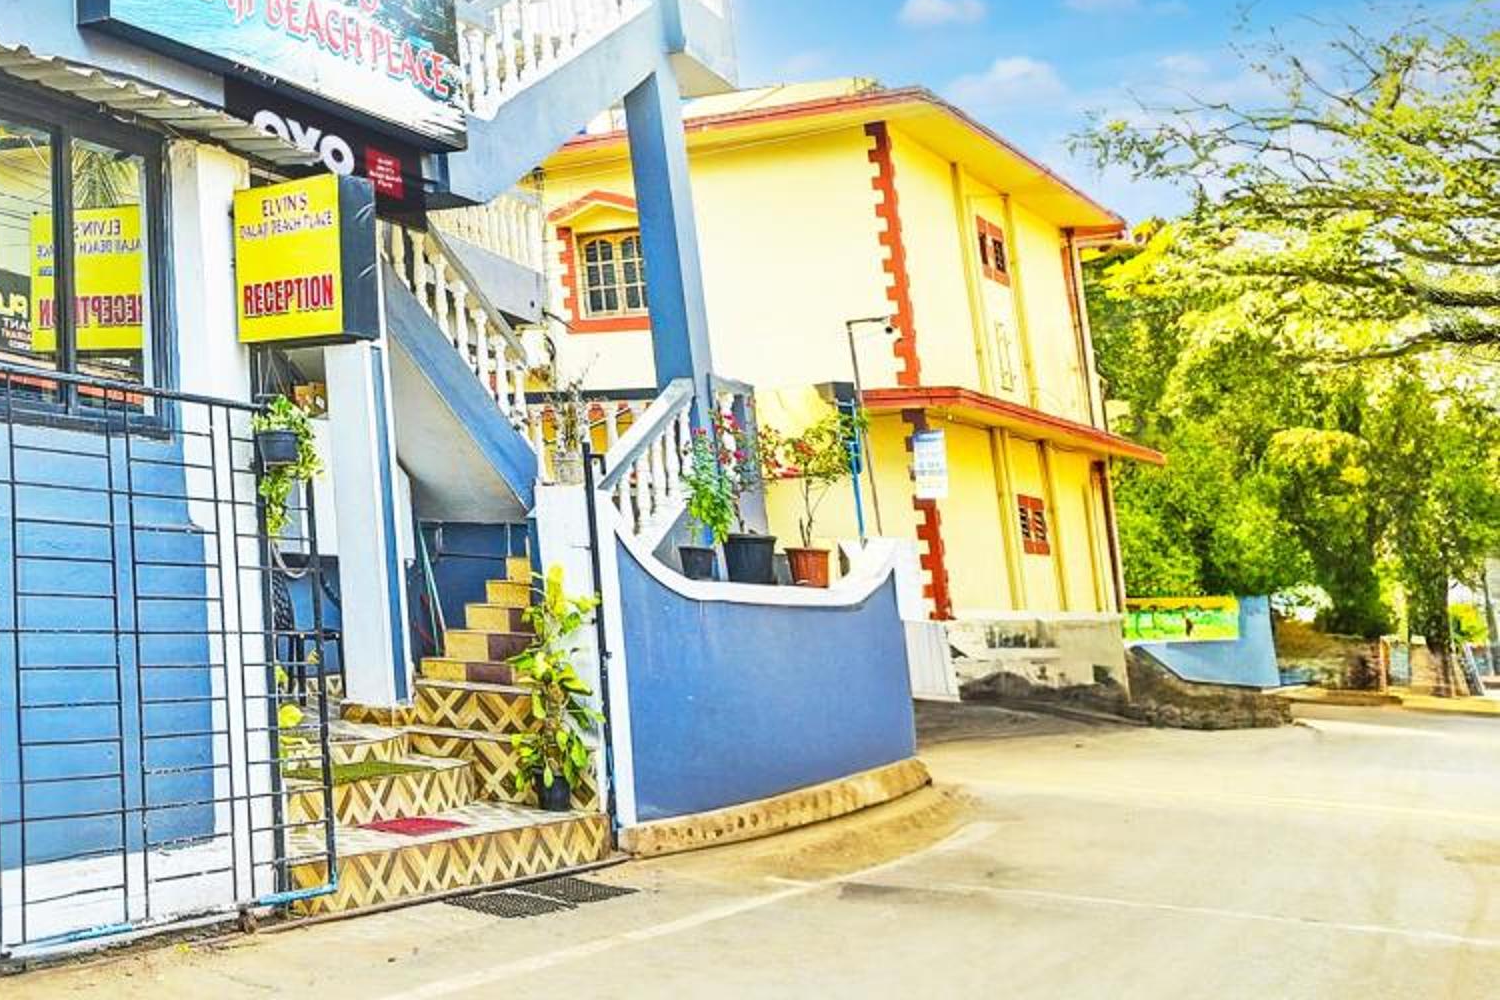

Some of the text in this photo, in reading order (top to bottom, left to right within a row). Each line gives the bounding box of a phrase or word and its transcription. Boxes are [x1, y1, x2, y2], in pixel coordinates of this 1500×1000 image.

[369, 23, 448, 95] PLACE
[254, 109, 355, 176] OYO
[243, 274, 334, 317] RECEPTION
